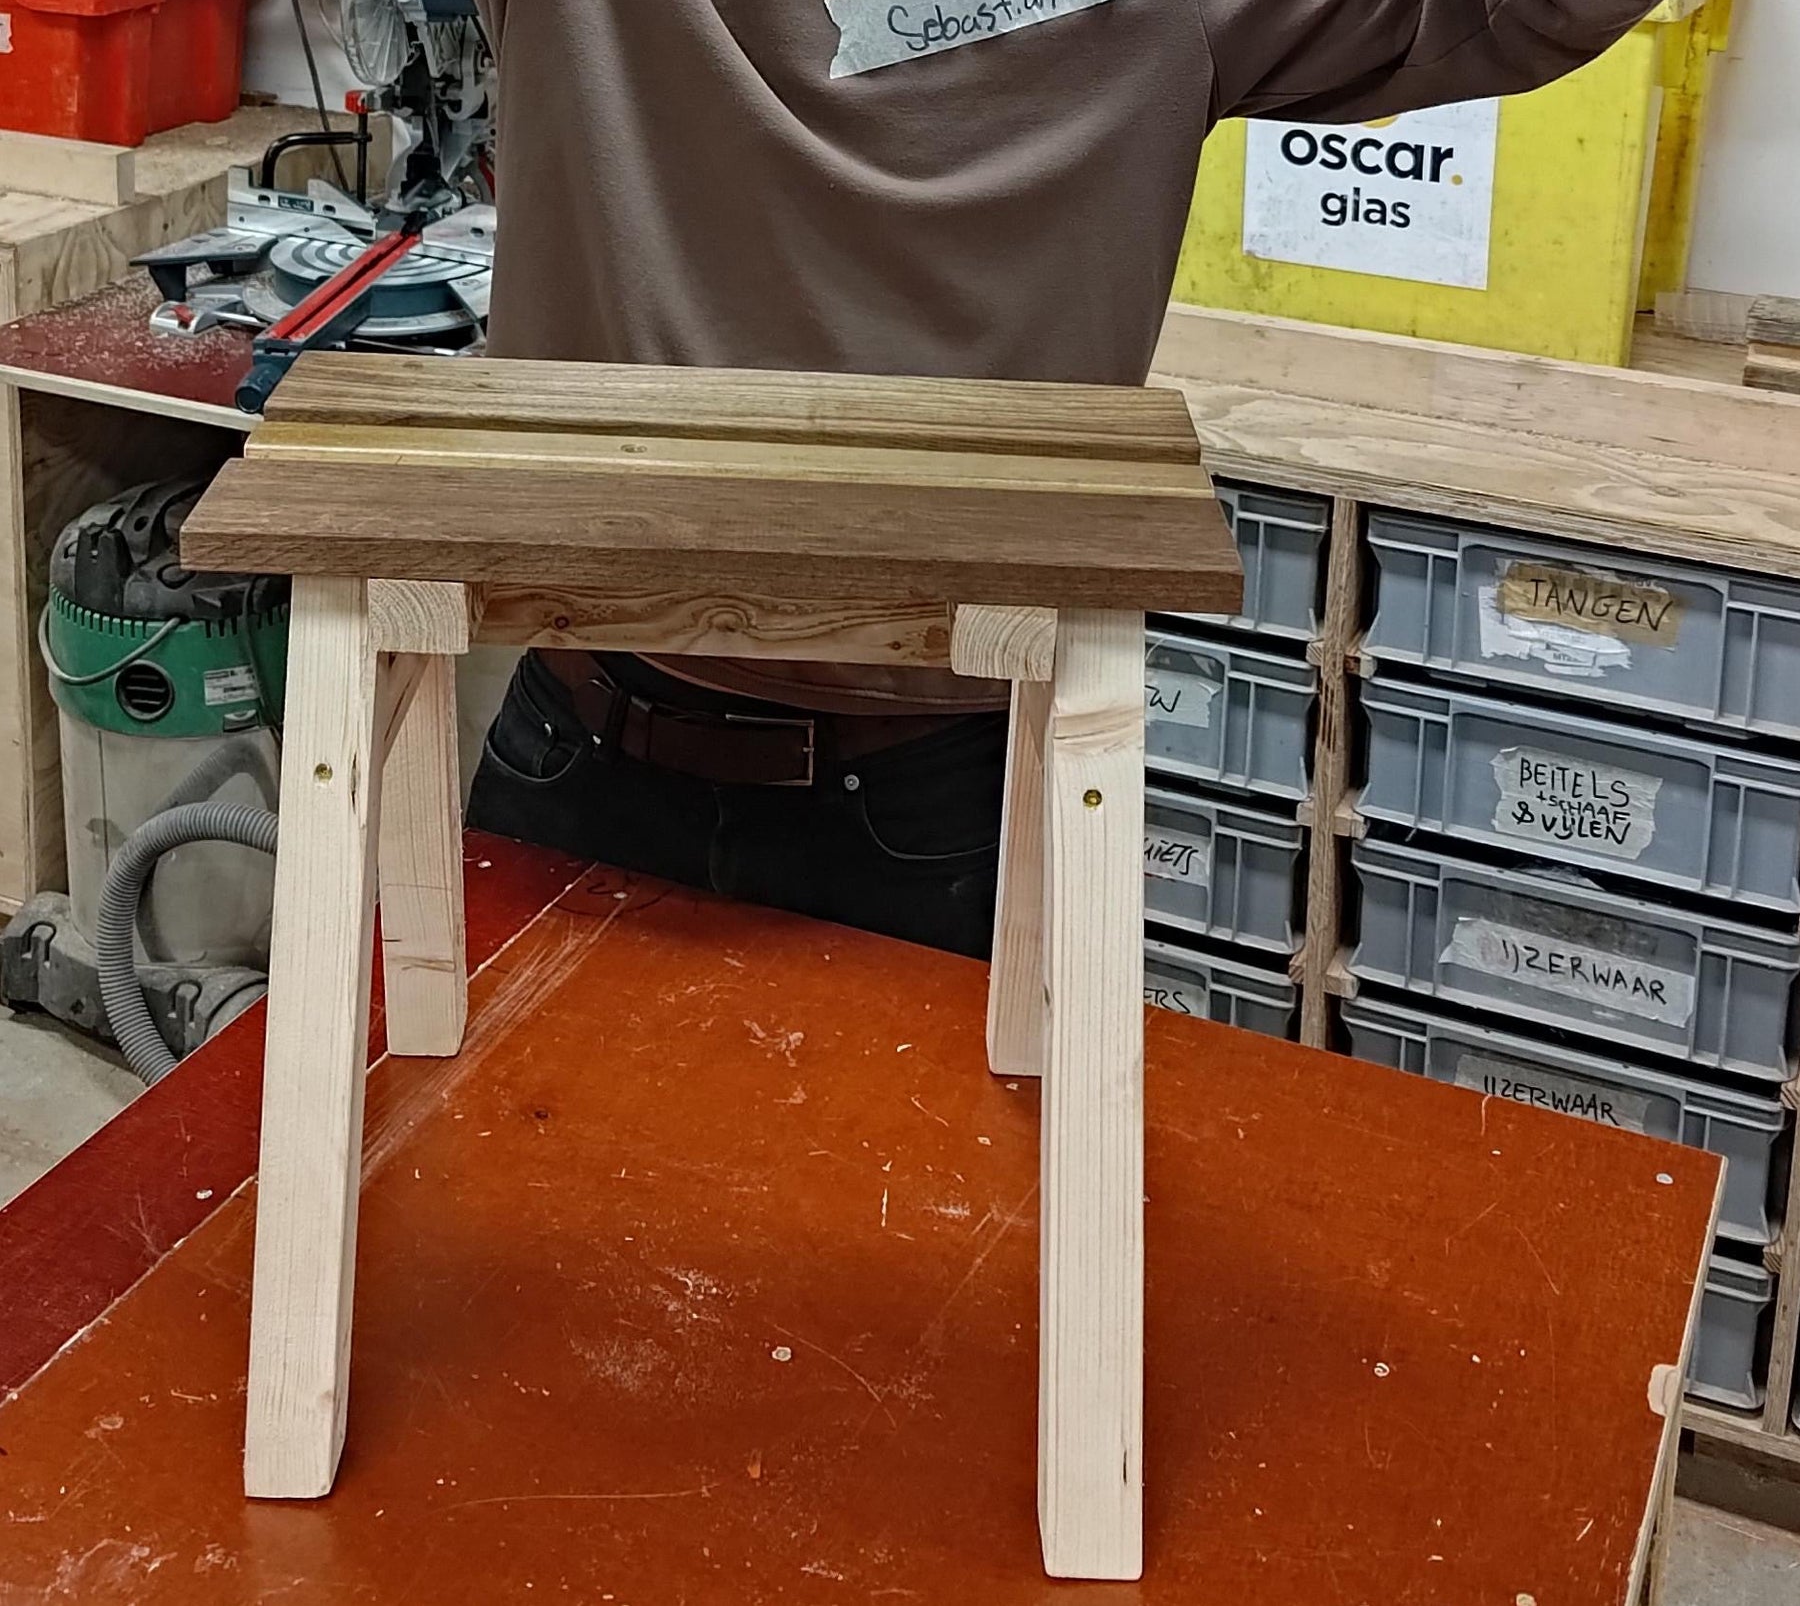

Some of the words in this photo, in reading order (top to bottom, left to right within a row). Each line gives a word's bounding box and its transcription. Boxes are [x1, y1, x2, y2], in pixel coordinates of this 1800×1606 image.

[1320, 187, 1411, 228] glas
[1529, 578, 1675, 632] TANGEN
[1519, 757, 1630, 808] BEITELS
